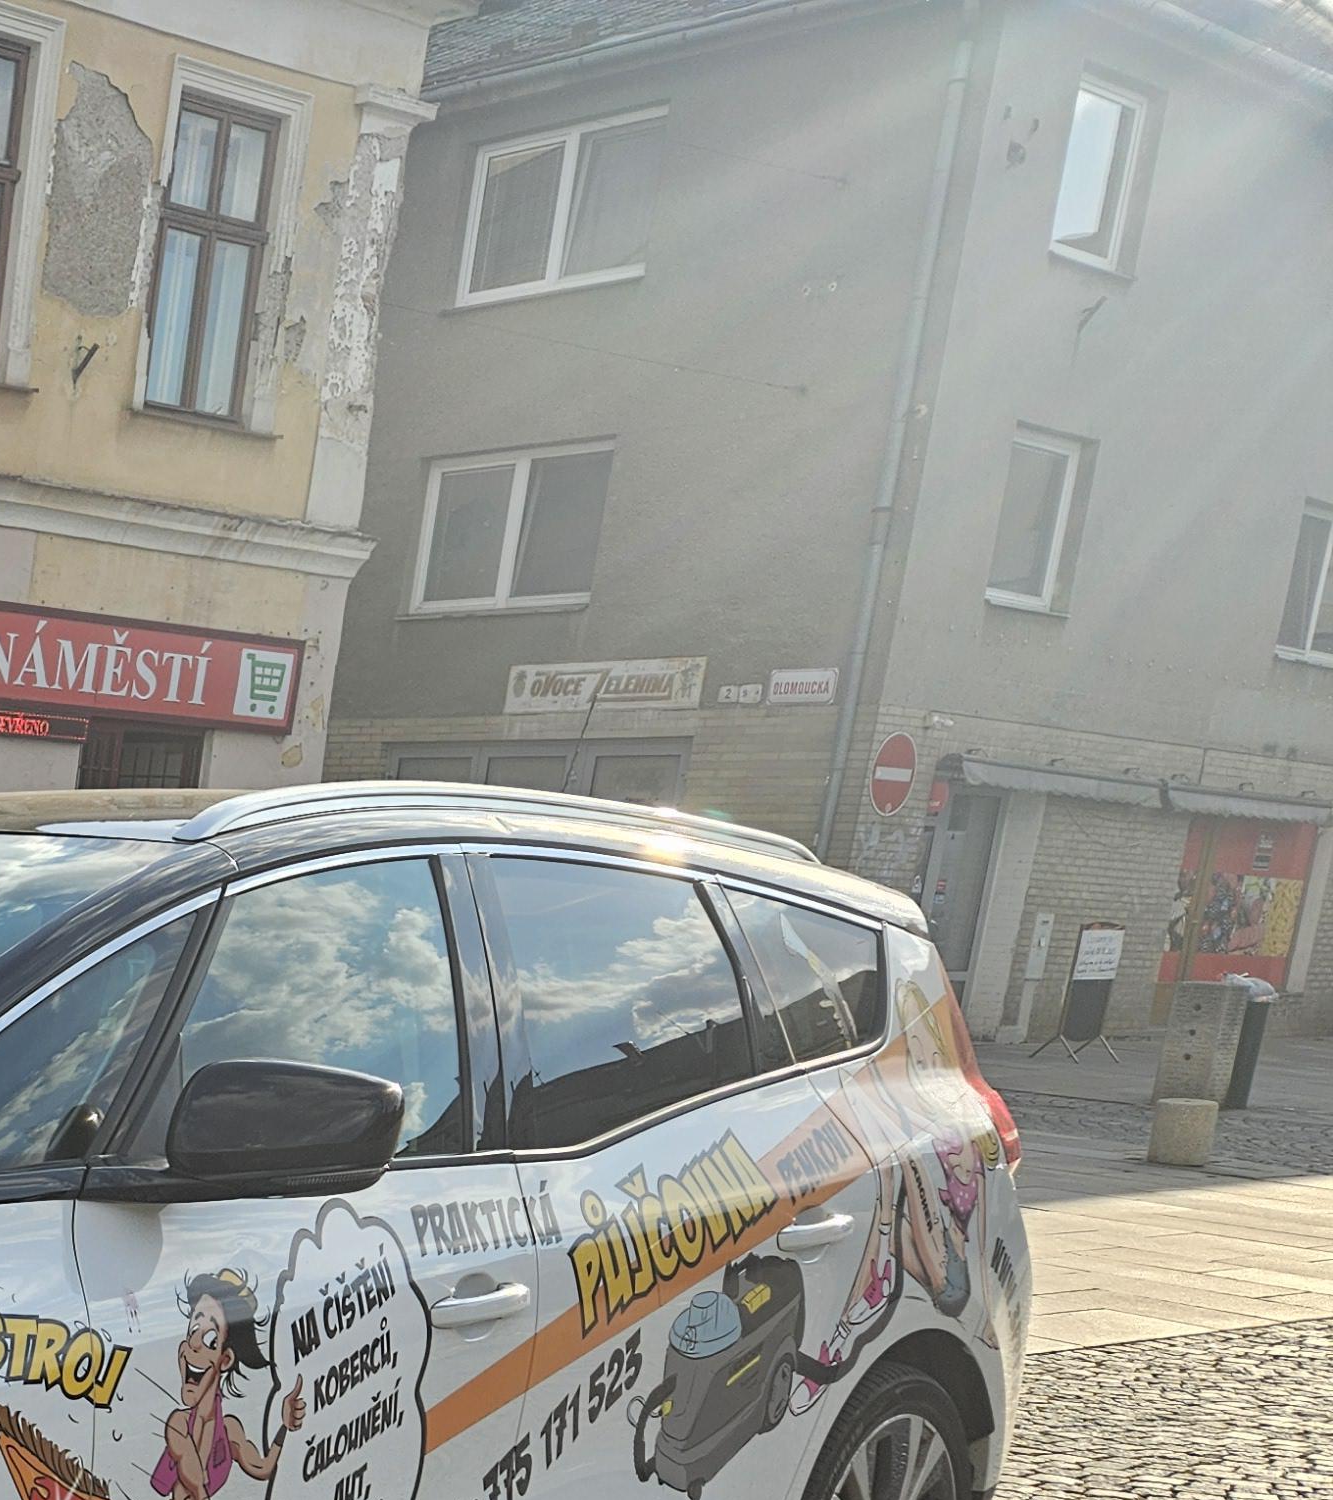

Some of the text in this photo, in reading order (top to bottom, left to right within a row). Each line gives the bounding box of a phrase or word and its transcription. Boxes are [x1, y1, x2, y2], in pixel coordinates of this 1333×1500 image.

[410, 1180, 563, 1257] PRAKTICKÁ
[569, 1128, 780, 1339] PŮJČOVNA
[290, 1243, 396, 1366] NA ČIŠTĚNÍ
[313, 1317, 399, 1414] KOBERCŮ,
[302, 1376, 405, 1482] ČALOUNĚNÍ,
[539, 1383, 582, 1471] 171
[587, 1327, 645, 1425] 523
